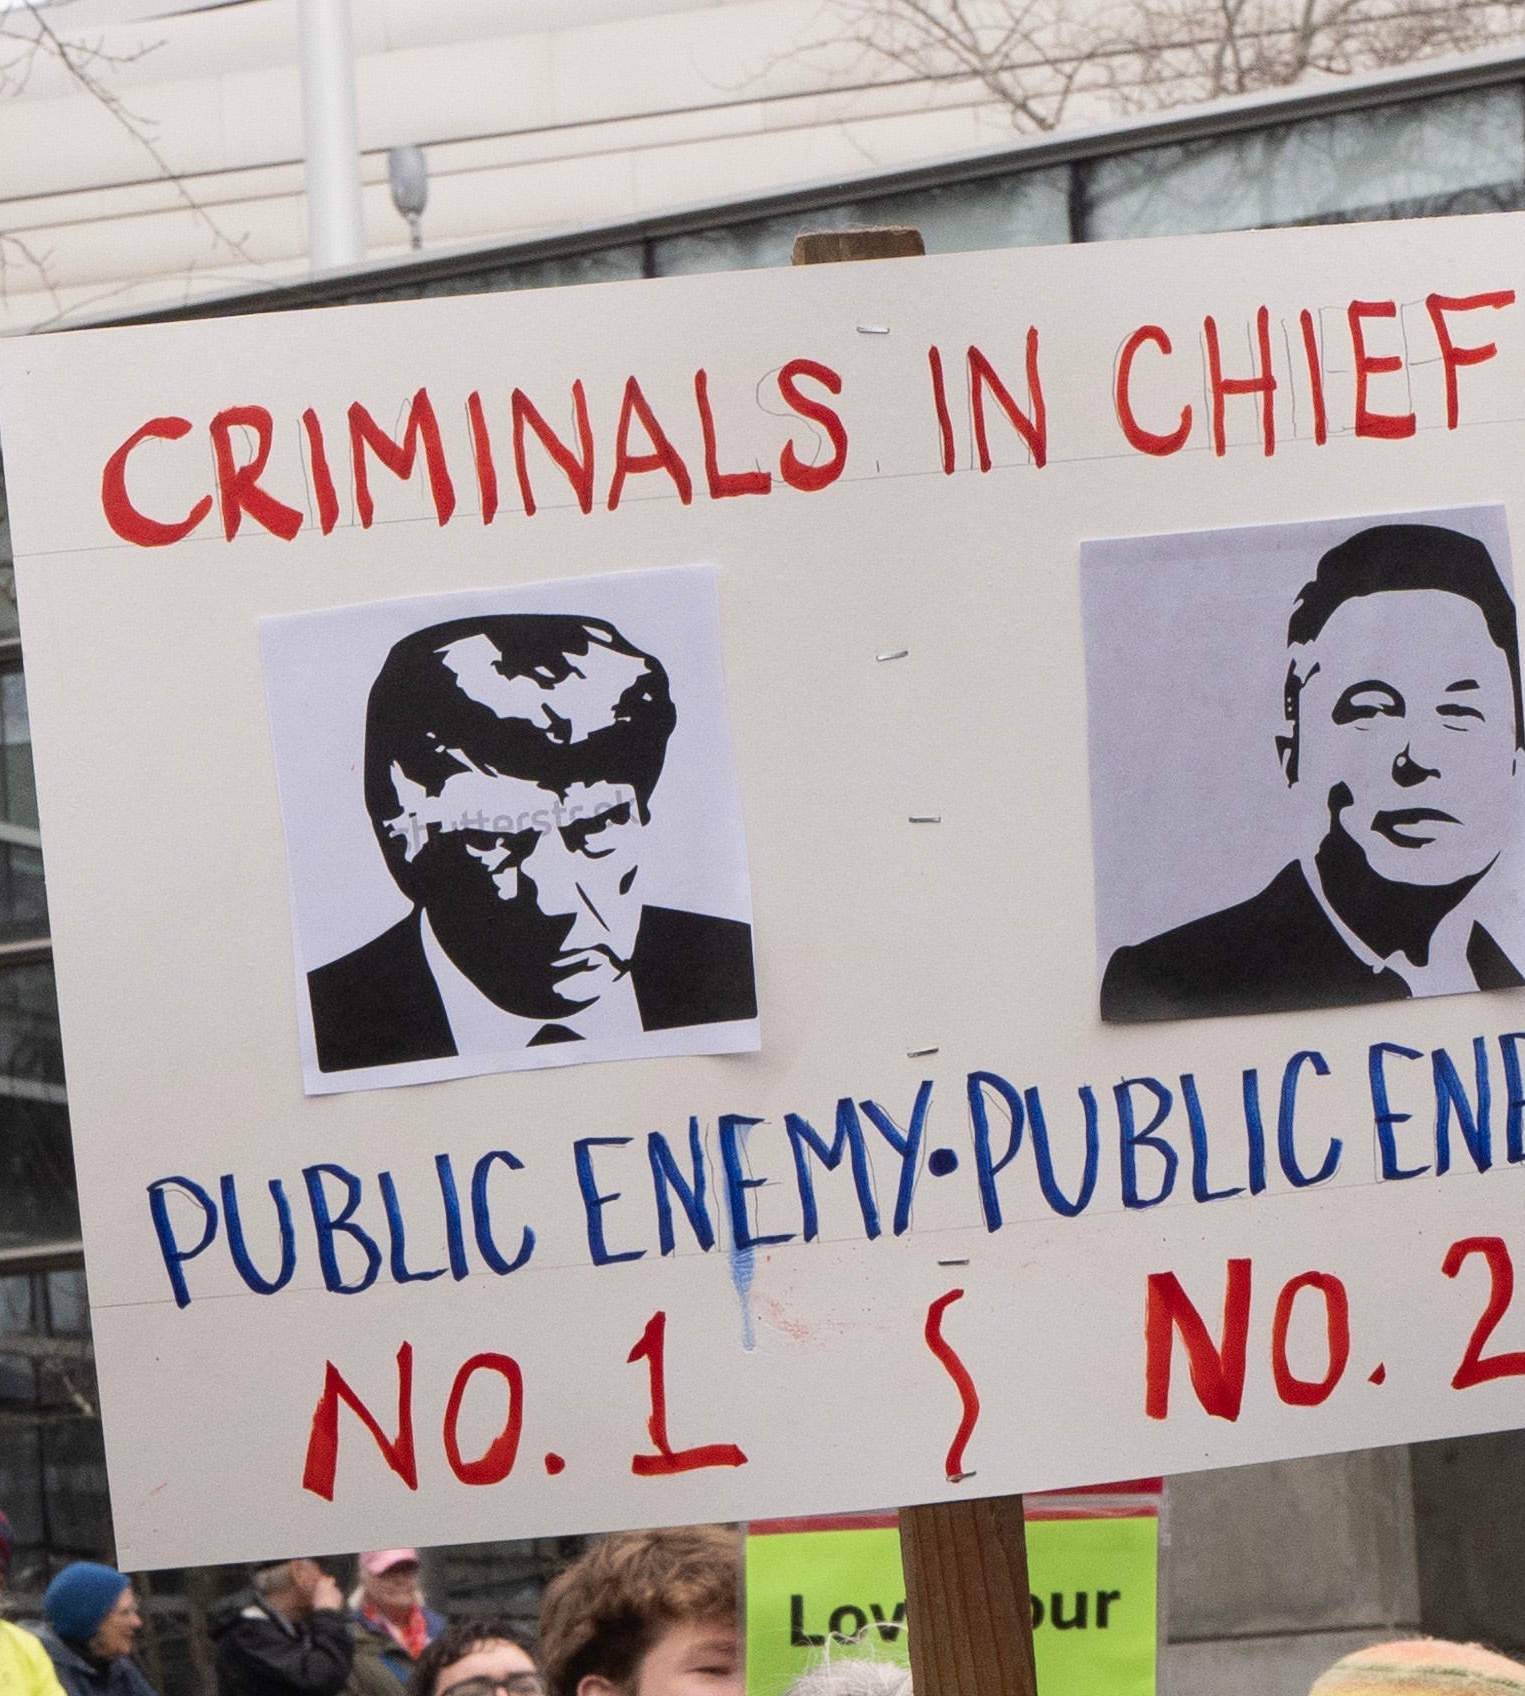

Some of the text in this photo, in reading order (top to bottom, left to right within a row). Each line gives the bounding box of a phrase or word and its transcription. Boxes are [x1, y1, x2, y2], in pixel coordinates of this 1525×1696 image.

[100, 289, 1516, 548] CRIMINALS IN CHIEF
[147, 1080, 934, 1308] PUBLIC ENEMY
[967, 1050, 1343, 1233] PUBLIC
[302, 1310, 749, 1502] NO. 1
[1144, 1257, 1386, 1422] NO.
[789, 1593, 908, 1648] Lov
